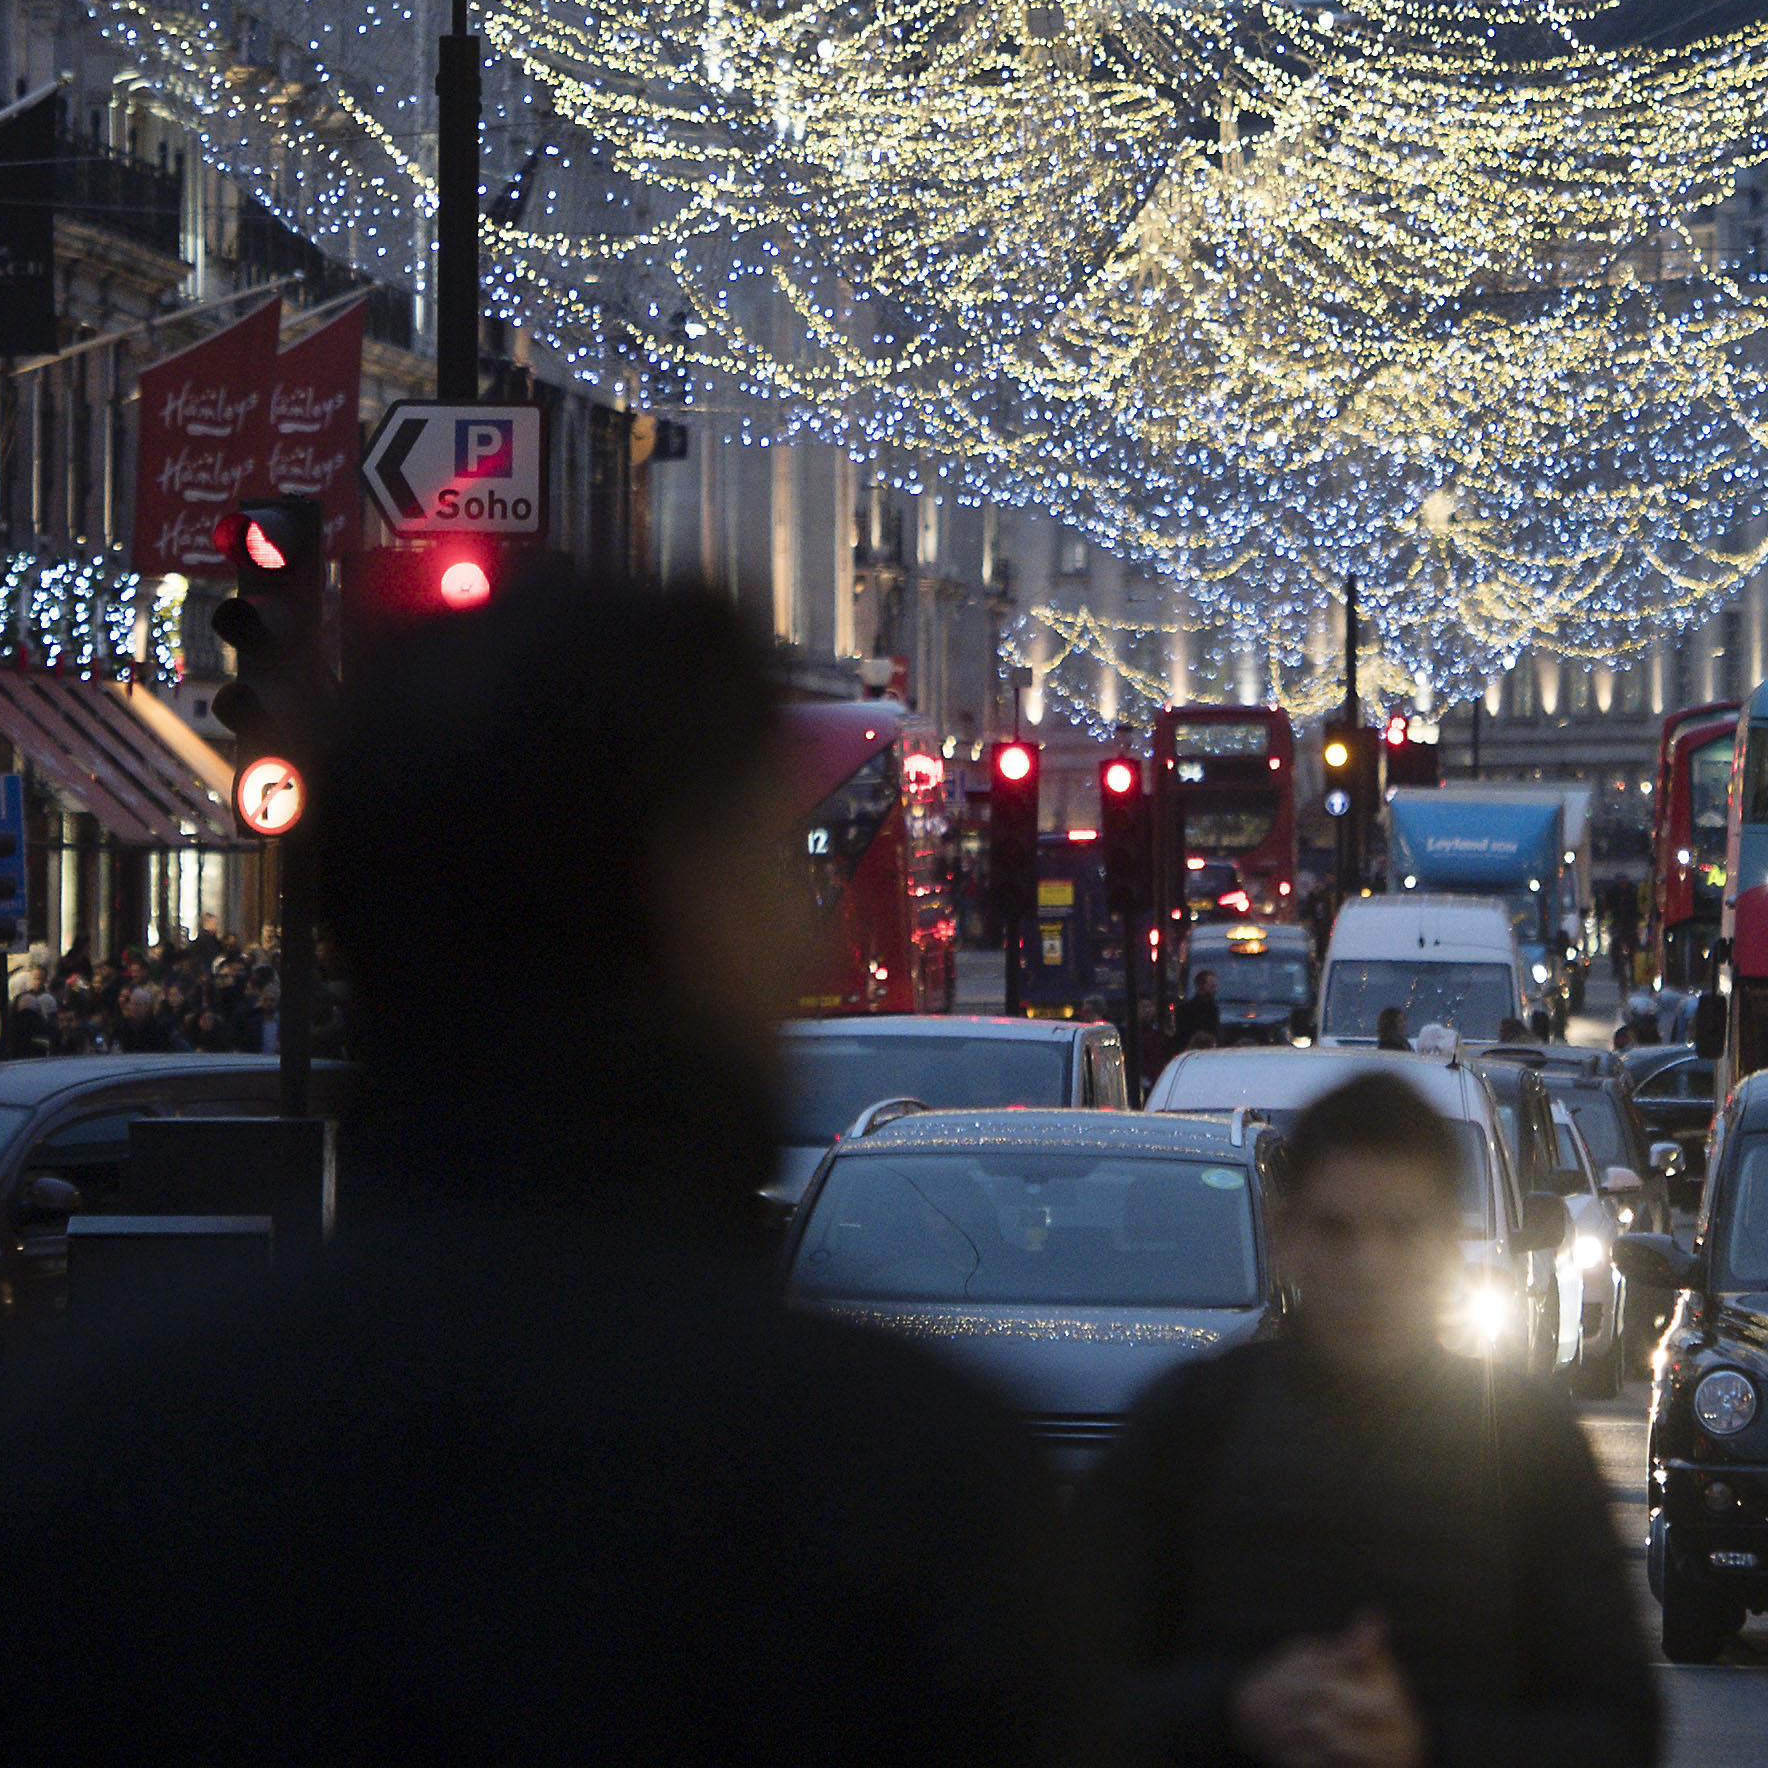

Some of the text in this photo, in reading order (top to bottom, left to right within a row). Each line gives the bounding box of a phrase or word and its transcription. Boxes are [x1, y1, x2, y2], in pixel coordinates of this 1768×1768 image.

[160, 380, 259, 434] Hamleys
[156, 445, 256, 497] Hamleys
[467, 424, 503, 473] P
[436, 489, 531, 520] Soho
[806, 826, 830, 855] 12
